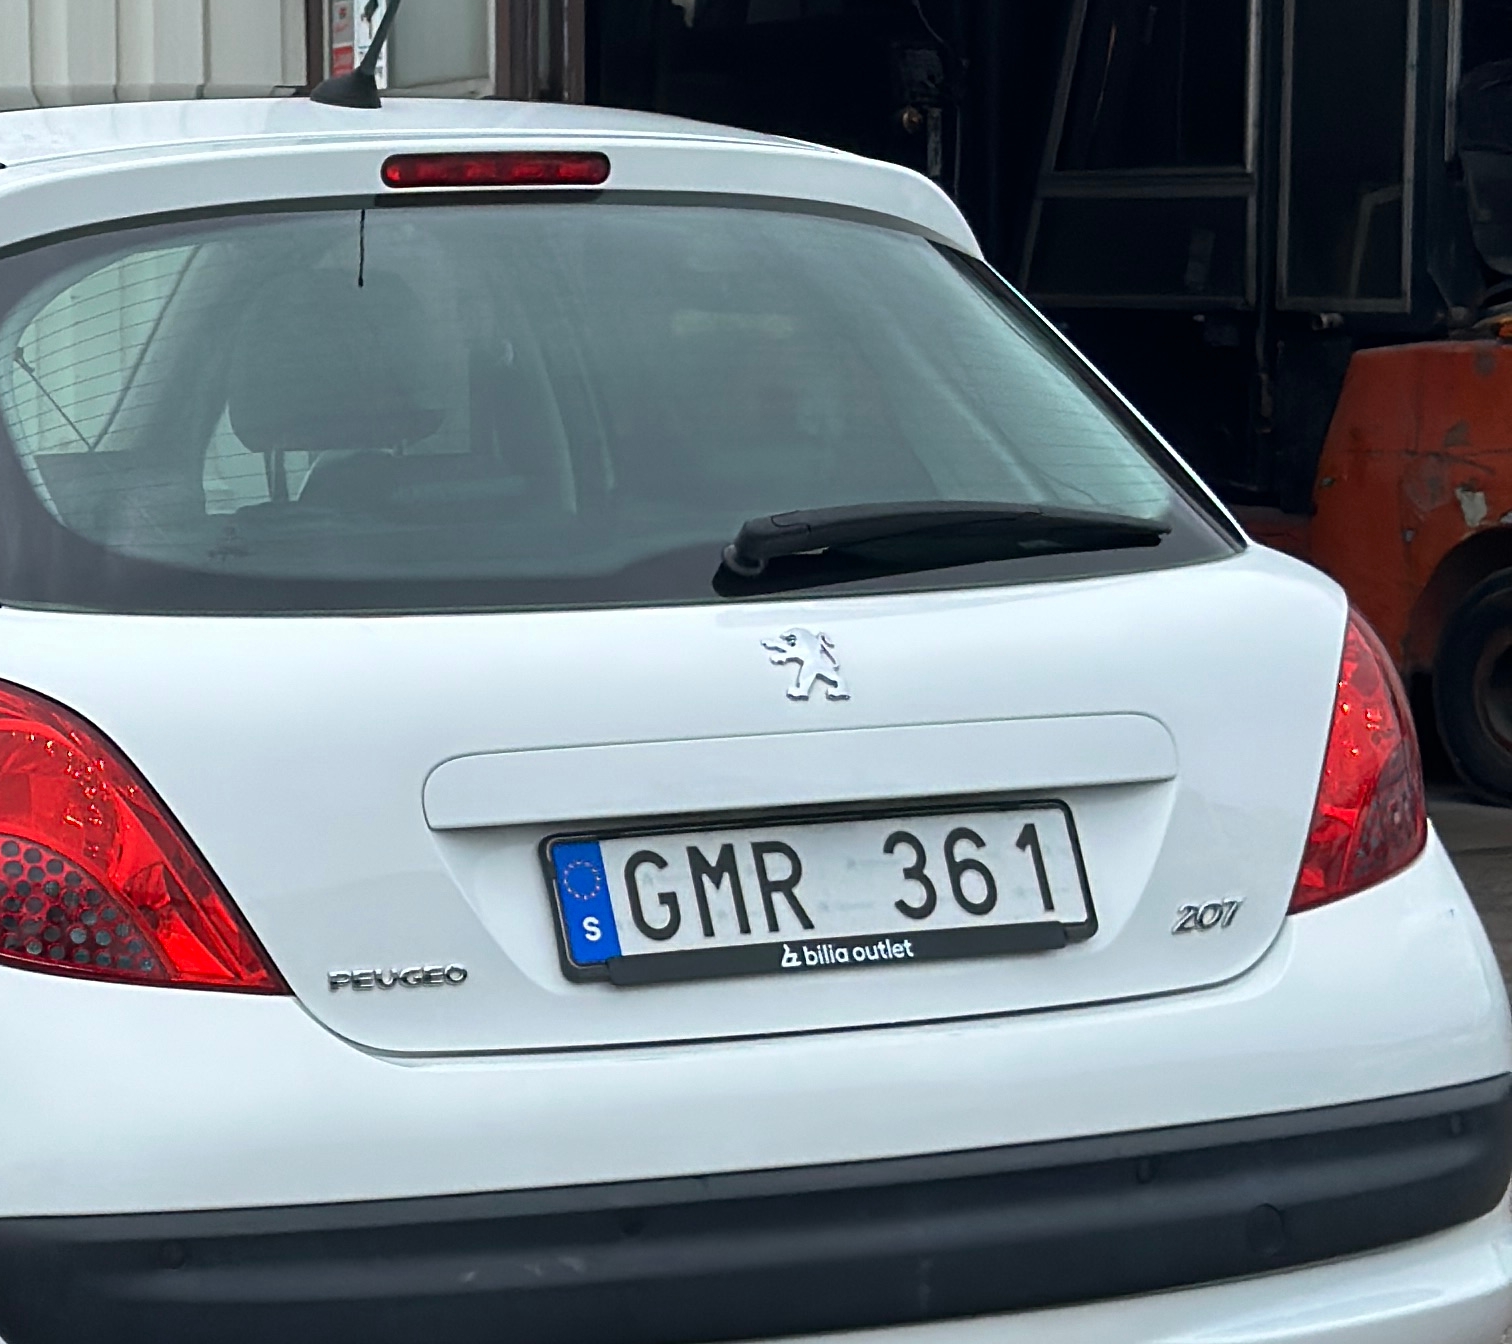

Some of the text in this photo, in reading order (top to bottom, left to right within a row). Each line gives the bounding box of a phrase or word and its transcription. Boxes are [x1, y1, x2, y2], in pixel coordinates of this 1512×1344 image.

[624, 822, 1055, 941] GMR 361
[582, 916, 602, 942] S
[1171, 896, 1247, 935] 207
[803, 938, 914, 966] bilia outlet
[328, 963, 468, 992] PEUGEO
